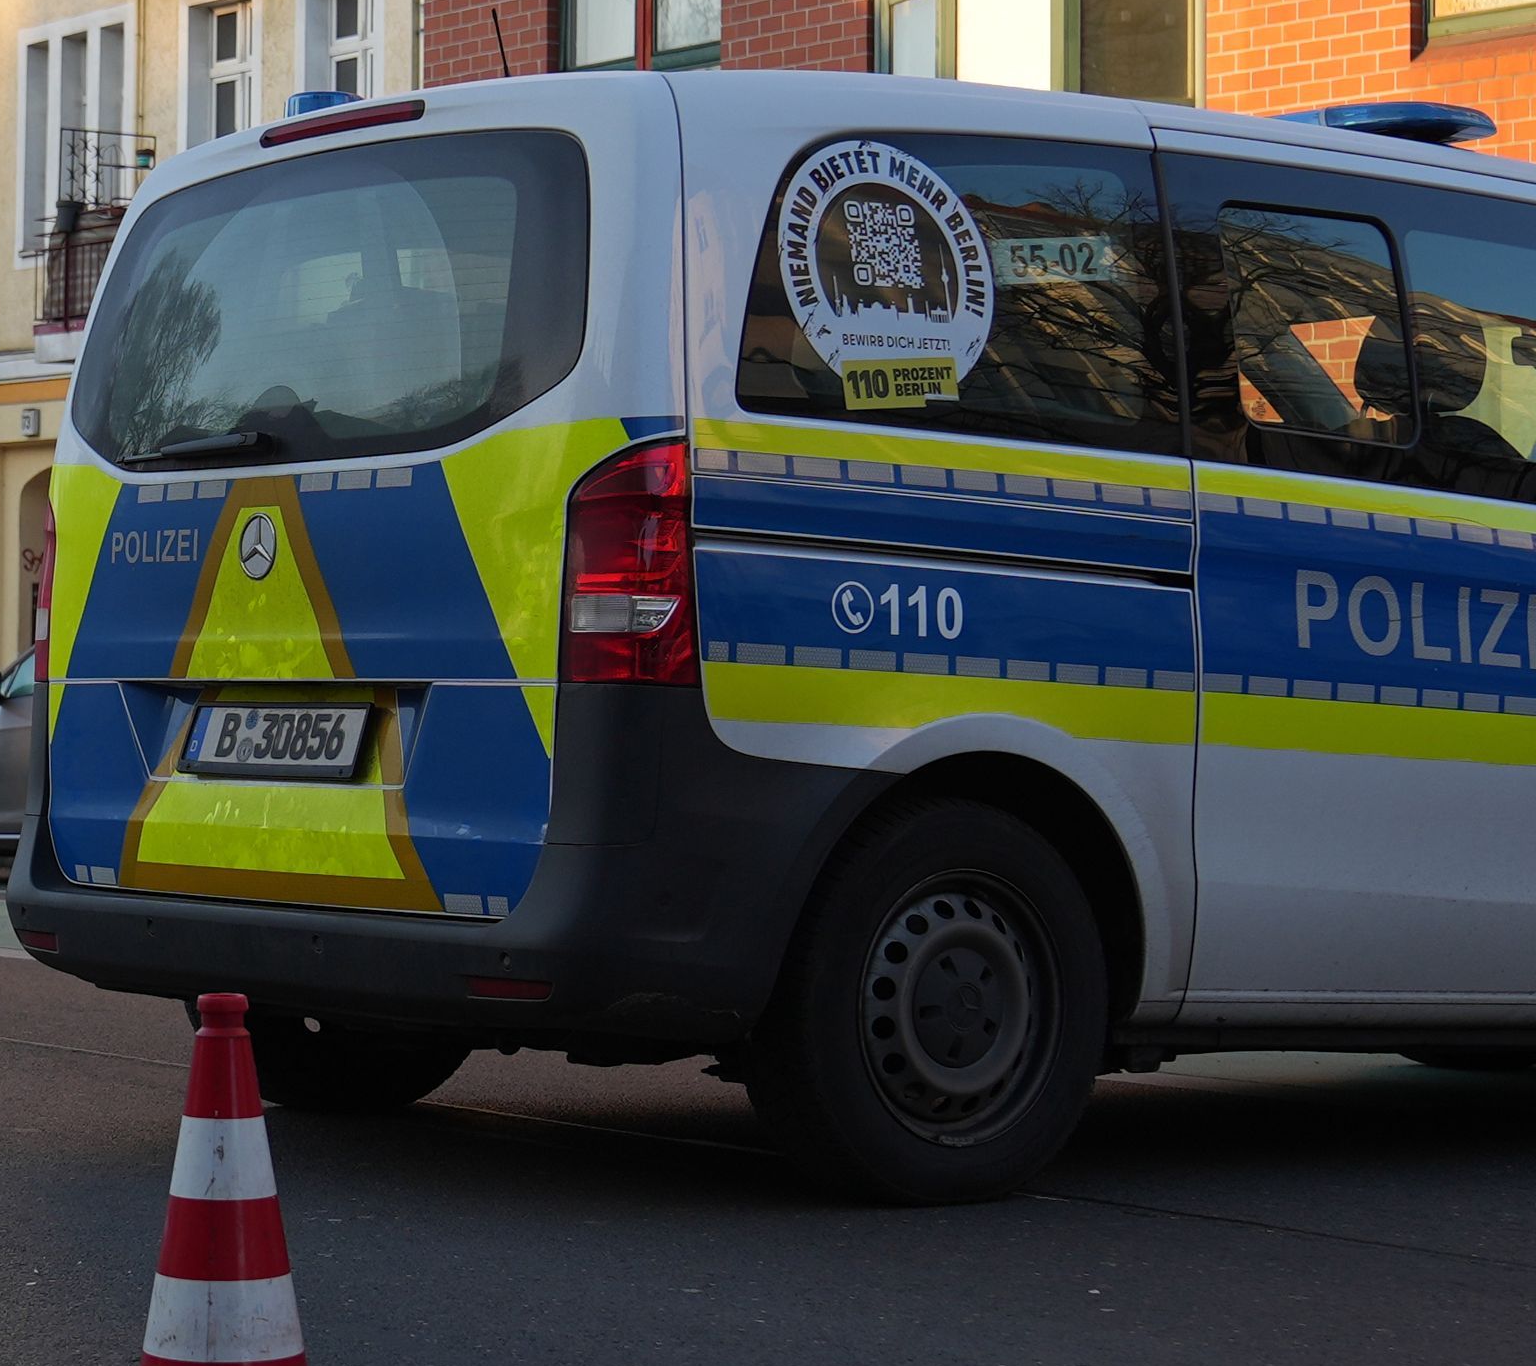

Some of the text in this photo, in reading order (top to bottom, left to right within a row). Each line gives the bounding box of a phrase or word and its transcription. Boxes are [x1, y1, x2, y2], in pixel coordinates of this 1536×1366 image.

[787, 186, 819, 308] NIEMAND
[888, 156, 949, 212] MEHR
[944, 210, 986, 319] BERLIN!
[1010, 242, 1097, 277] 55-02
[842, 334, 951, 351] BEWIRB DICH JETZT!
[846, 367, 952, 399] 110 PROZENT
[895, 382, 942, 396] BERLIN
[111, 528, 199, 564] POLIZEI
[880, 584, 963, 640] 110
[214, 713, 251, 758] B
[253, 713, 346, 761] 30856
